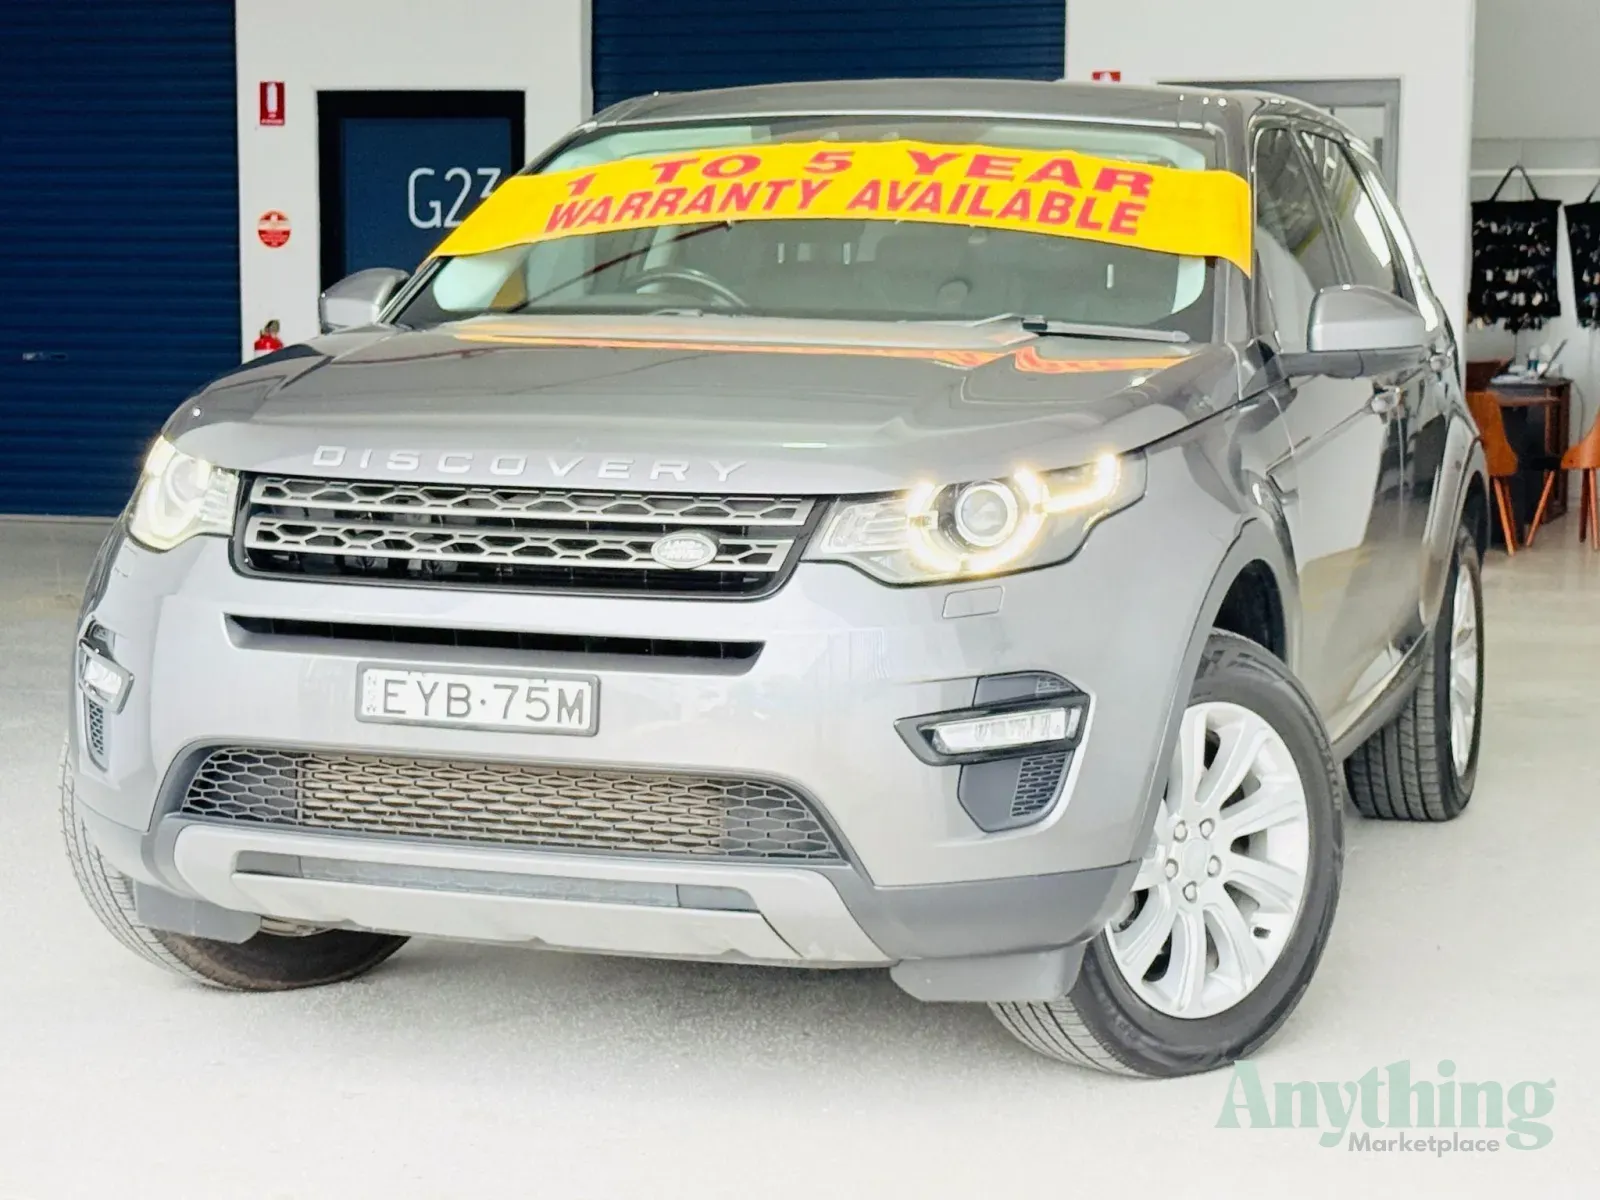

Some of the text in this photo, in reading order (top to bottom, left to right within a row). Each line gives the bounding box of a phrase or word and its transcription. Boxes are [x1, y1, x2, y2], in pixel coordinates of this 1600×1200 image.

[566, 150, 1154, 198] 1 TO 5 YEAR
[544, 179, 1146, 236] WARRANTY AVAILABLE
[313, 445, 747, 482] DISCOVERY
